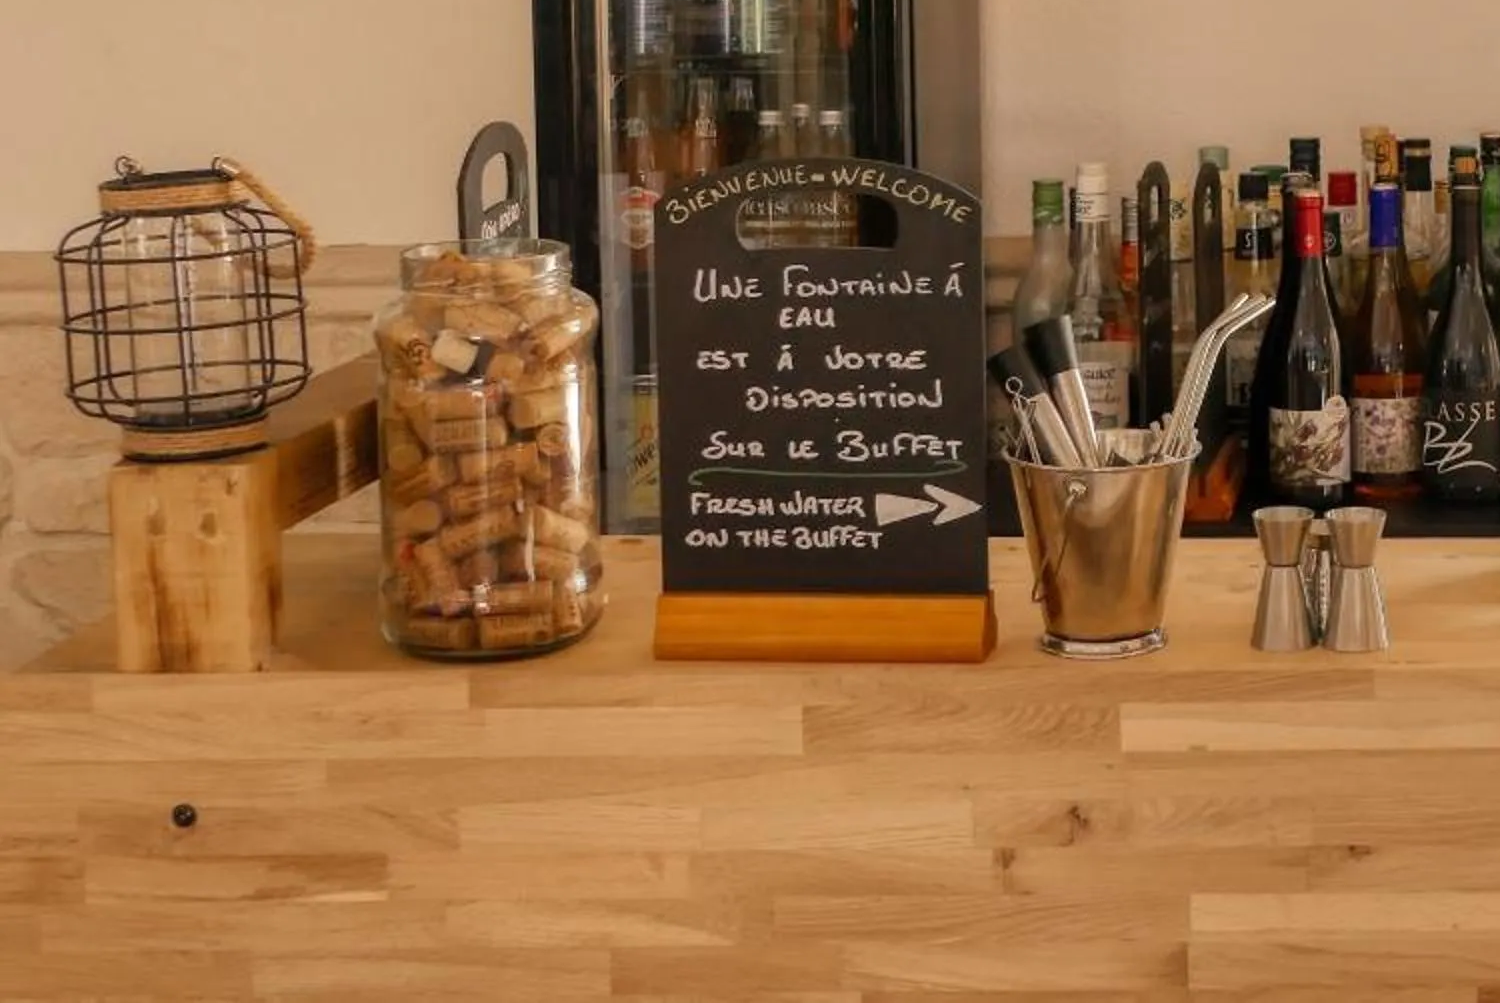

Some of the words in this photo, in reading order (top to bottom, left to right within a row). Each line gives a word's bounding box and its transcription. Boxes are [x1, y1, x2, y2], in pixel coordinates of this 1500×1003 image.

[779, 307, 836, 329] EAU
[696, 350, 751, 371] EST
[702, 431, 765, 460] SUR
[788, 439, 819, 459] LE
[689, 492, 774, 516] FRESH
[780, 491, 865, 518] WATER
[685, 529, 729, 548] ON
[737, 528, 788, 548] THE
[795, 526, 883, 550] BUFFET
